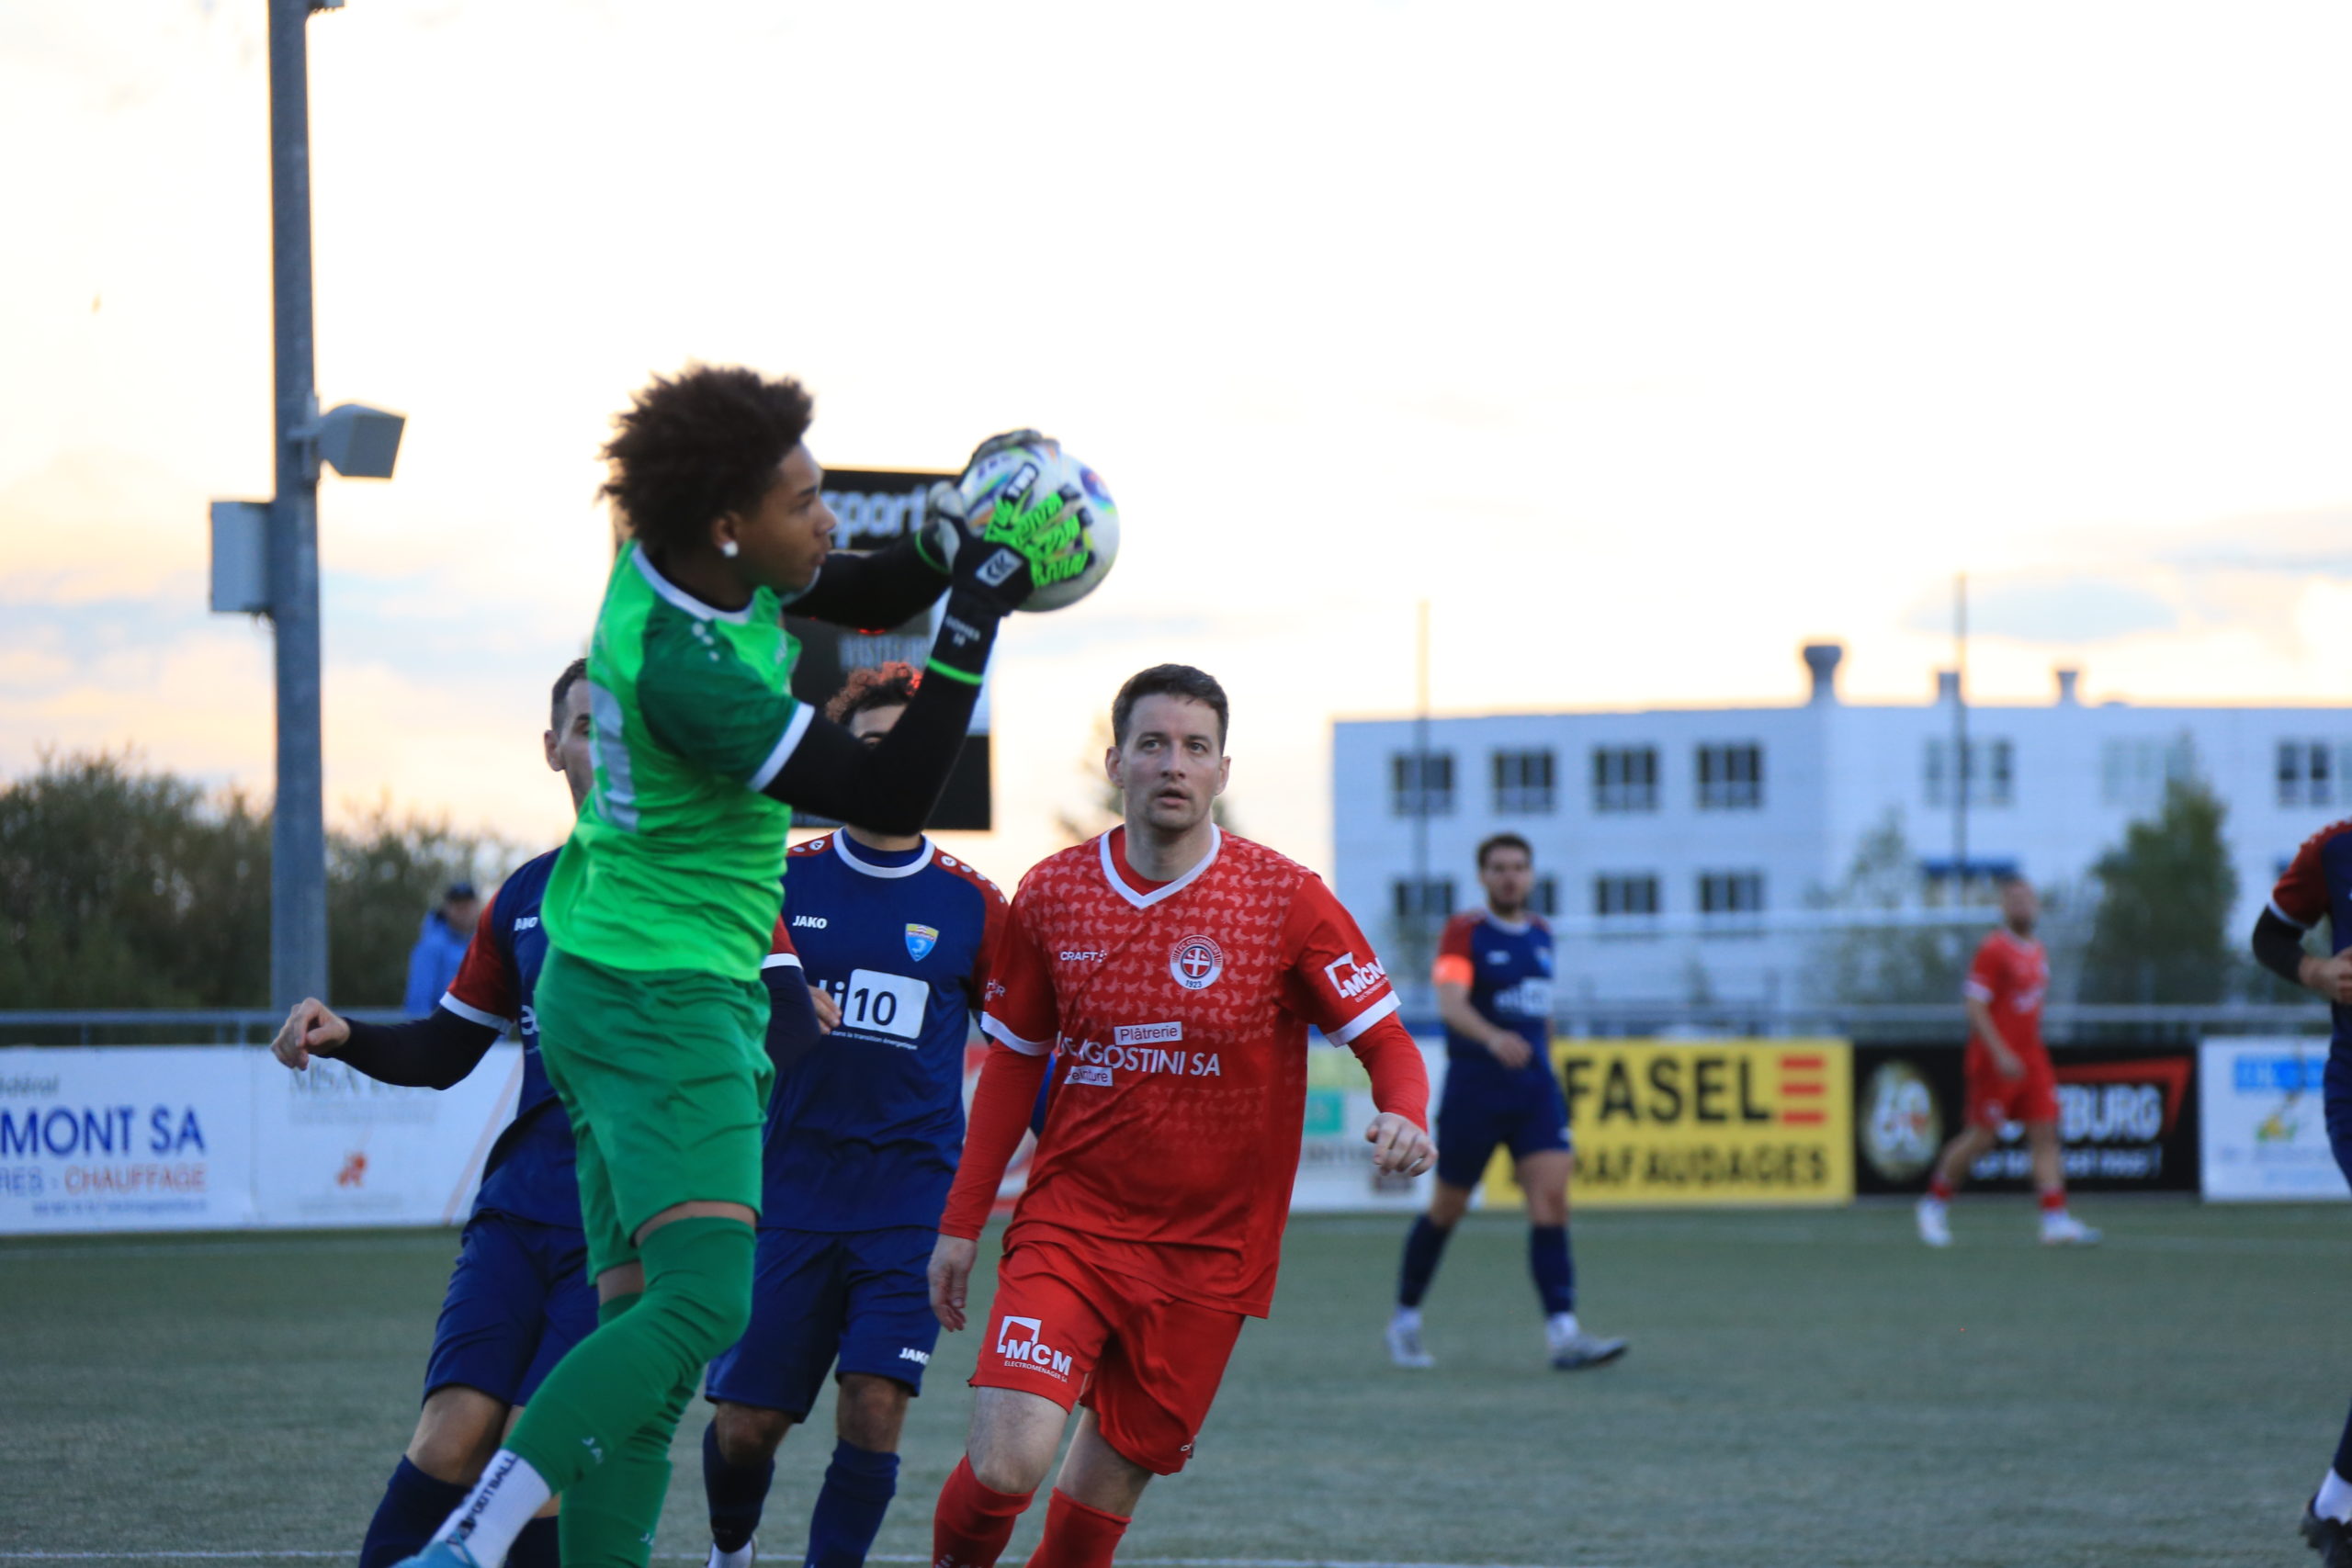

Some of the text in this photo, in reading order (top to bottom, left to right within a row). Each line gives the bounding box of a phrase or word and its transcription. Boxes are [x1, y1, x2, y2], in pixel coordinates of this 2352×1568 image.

[792, 915, 828, 930] JAKO
[1060, 951, 1098, 962] CRAFT
[1185, 979, 1203, 988] 1923
[1120, 1025, 1178, 1042] Plâtrerie
[1190, 1053, 1221, 1077] SA
[1069, 1068, 1109, 1083] einture
[1566, 1055, 1772, 1122] FASEL
[0, 1106, 206, 1157] MONT SA
[64, 1164, 206, 1193] CHAUFFAGE
[1005, 1338, 1072, 1377] MCM
